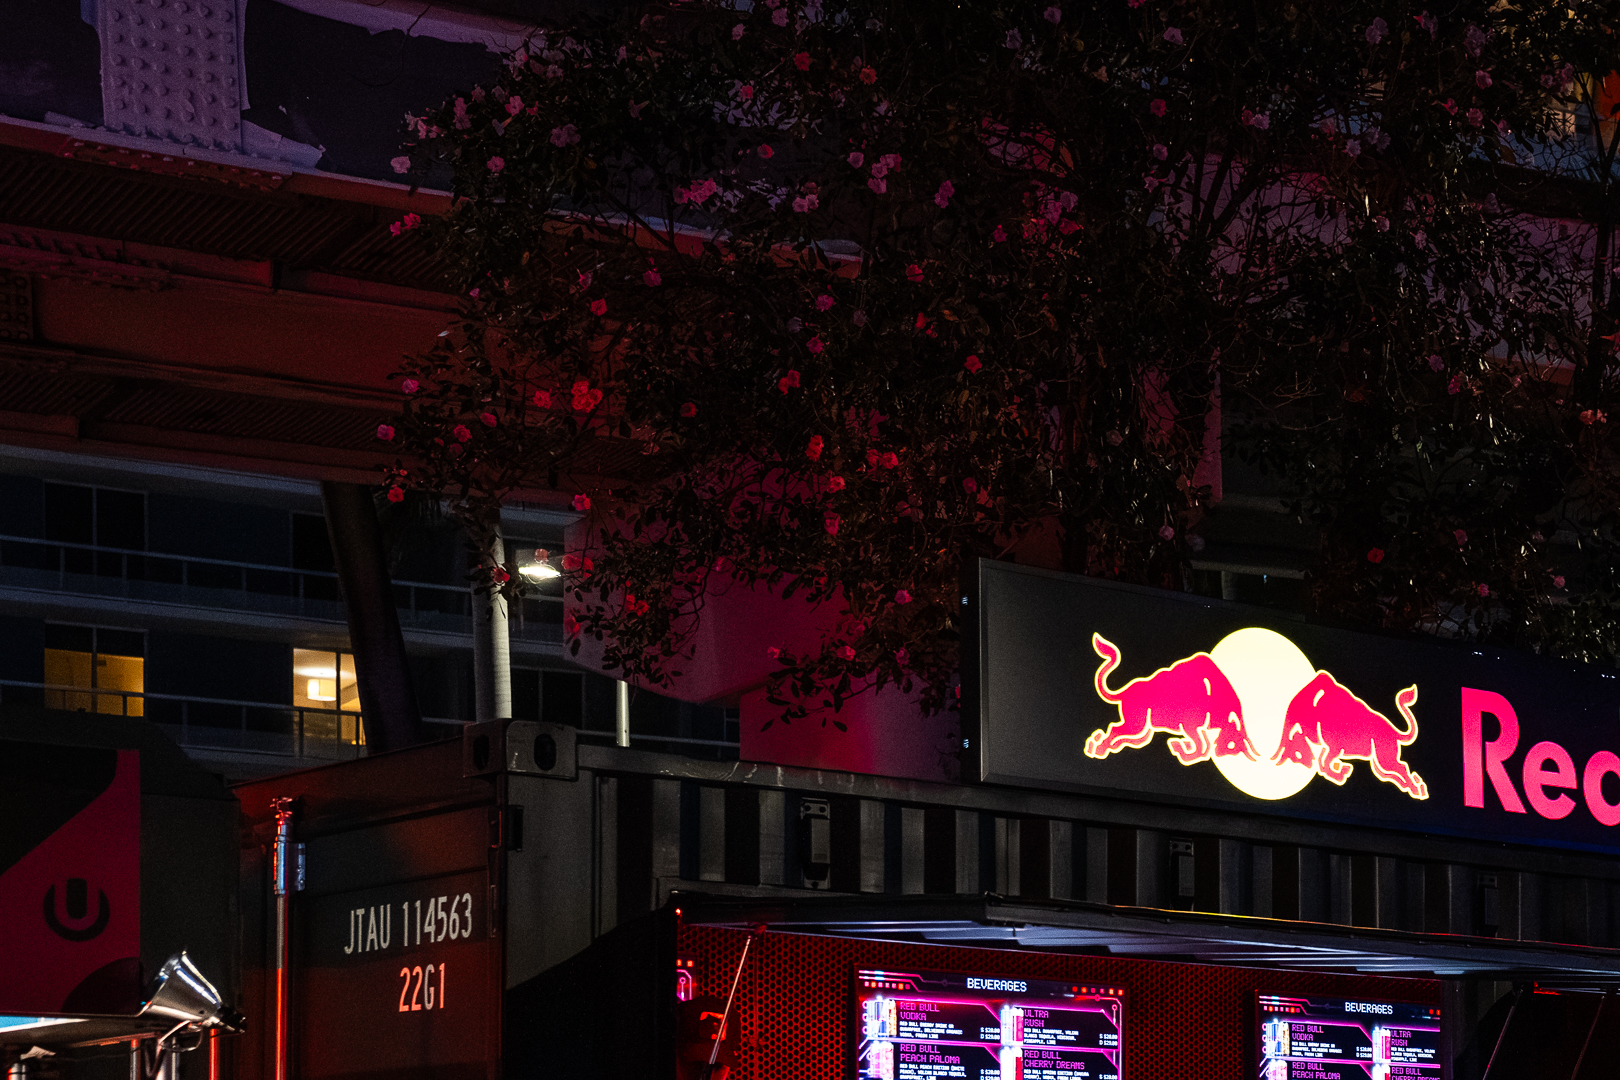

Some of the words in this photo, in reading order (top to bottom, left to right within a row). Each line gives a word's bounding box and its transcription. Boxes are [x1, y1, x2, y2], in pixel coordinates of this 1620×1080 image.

[344, 903, 391, 955] JTAU
[402, 892, 473, 947] 114563
[398, 962, 446, 1013] 22G1
[967, 977, 1028, 993] BEVERAGES
[900, 1002, 916, 1011] RED
[919, 1003, 940, 1013] BULL
[1344, 1001, 1393, 1015] BEVERAGES
[900, 1012, 927, 1021] VODKA
[1024, 1010, 1049, 1019] ULTRA
[1024, 1019, 1045, 1028] RUSH
[1292, 1024, 1305, 1032] RED
[1307, 1025, 1324, 1033] BULL
[1292, 1033, 1314, 1041] VODKA
[1391, 1030, 1411, 1038] ULTRA
[900, 1044, 916, 1052] RED
[919, 1045, 940, 1053] BULL
[900, 1053, 927, 1063] PEACH
[929, 1055, 960, 1064] PALOMA
[1024, 1050, 1039, 1058] RED
[1042, 1051, 1061, 1060] BULL
[1024, 1060, 1053, 1068] CHERRY
[1056, 1061, 1085, 1070] DREAMS
[1292, 1062, 1305, 1070] RED
[1308, 1063, 1324, 1071] BULL
[1292, 1070, 1314, 1079] PEACH
[1316, 1072, 1341, 1080] PALOMA
